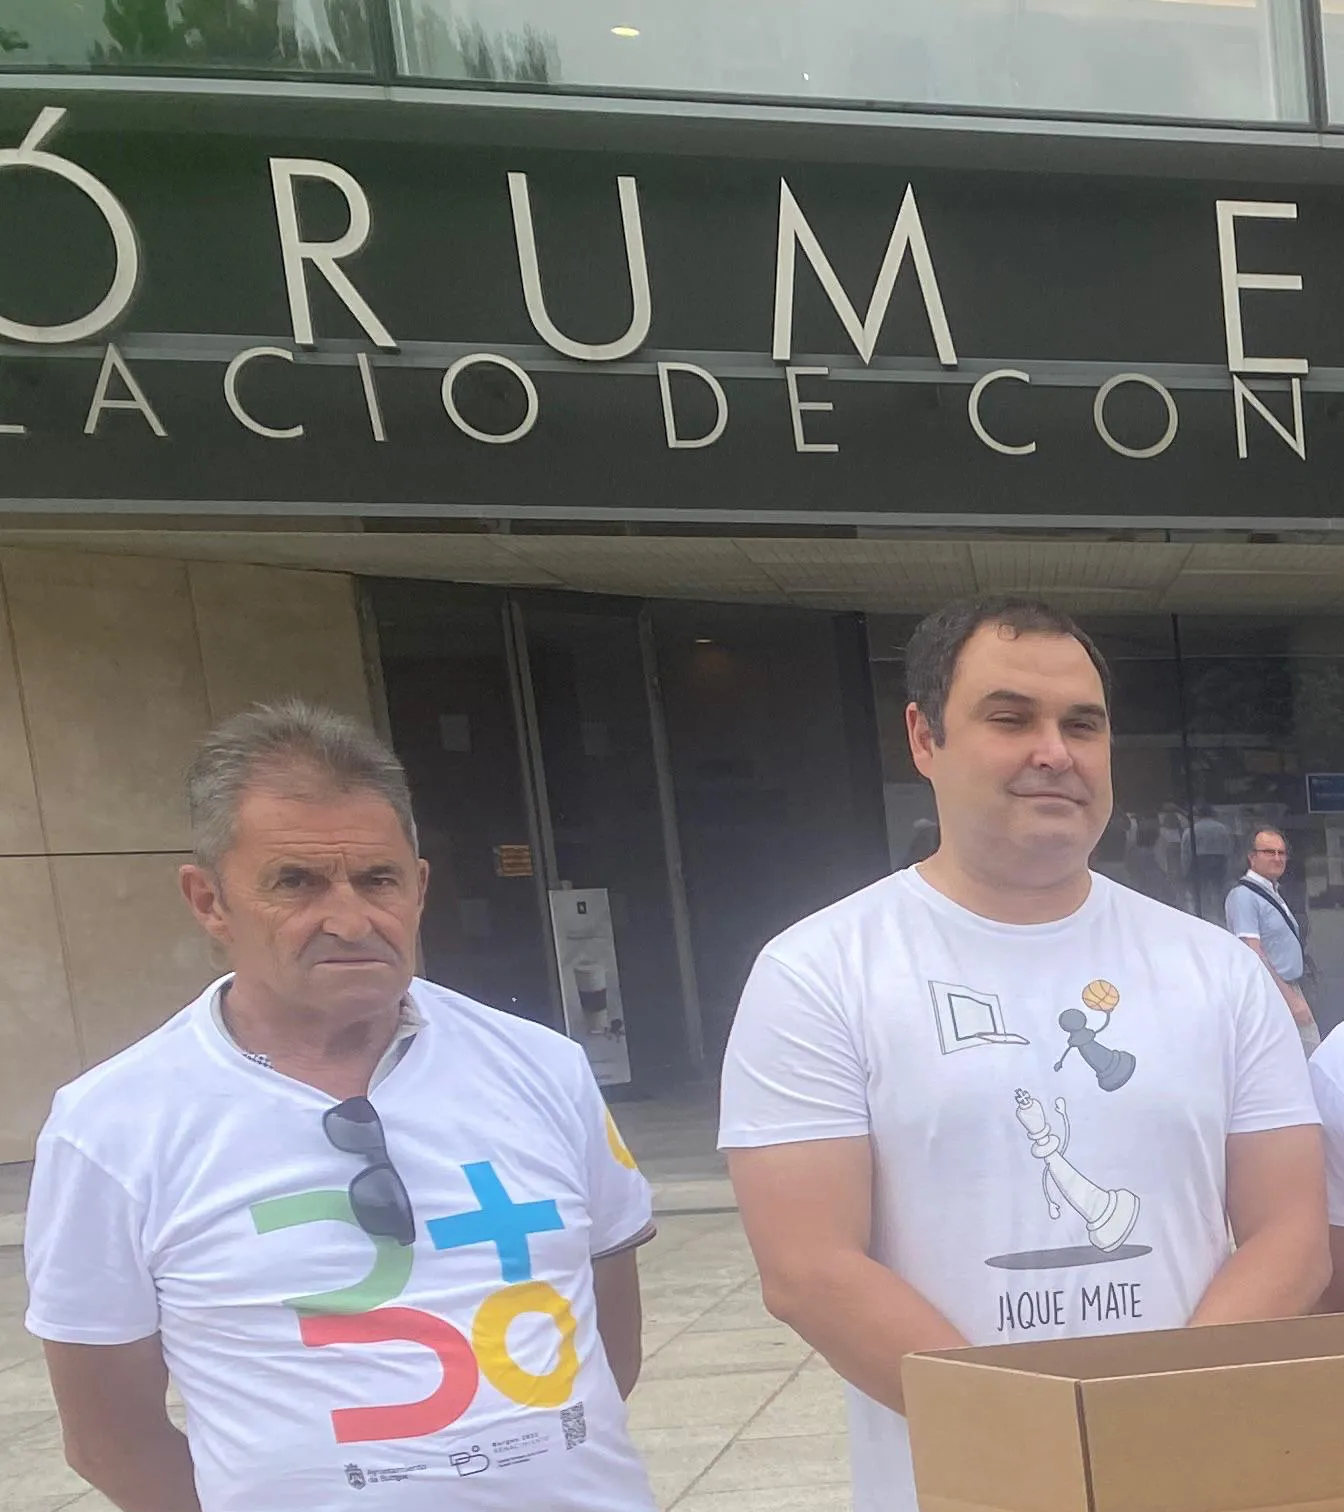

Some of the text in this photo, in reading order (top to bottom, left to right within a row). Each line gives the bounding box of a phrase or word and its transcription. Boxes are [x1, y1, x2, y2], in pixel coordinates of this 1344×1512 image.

[0, 342, 541, 446] ACIO
[657, 361, 840, 454] DE
[996, 1281, 1143, 1332] JAQUE MATE
